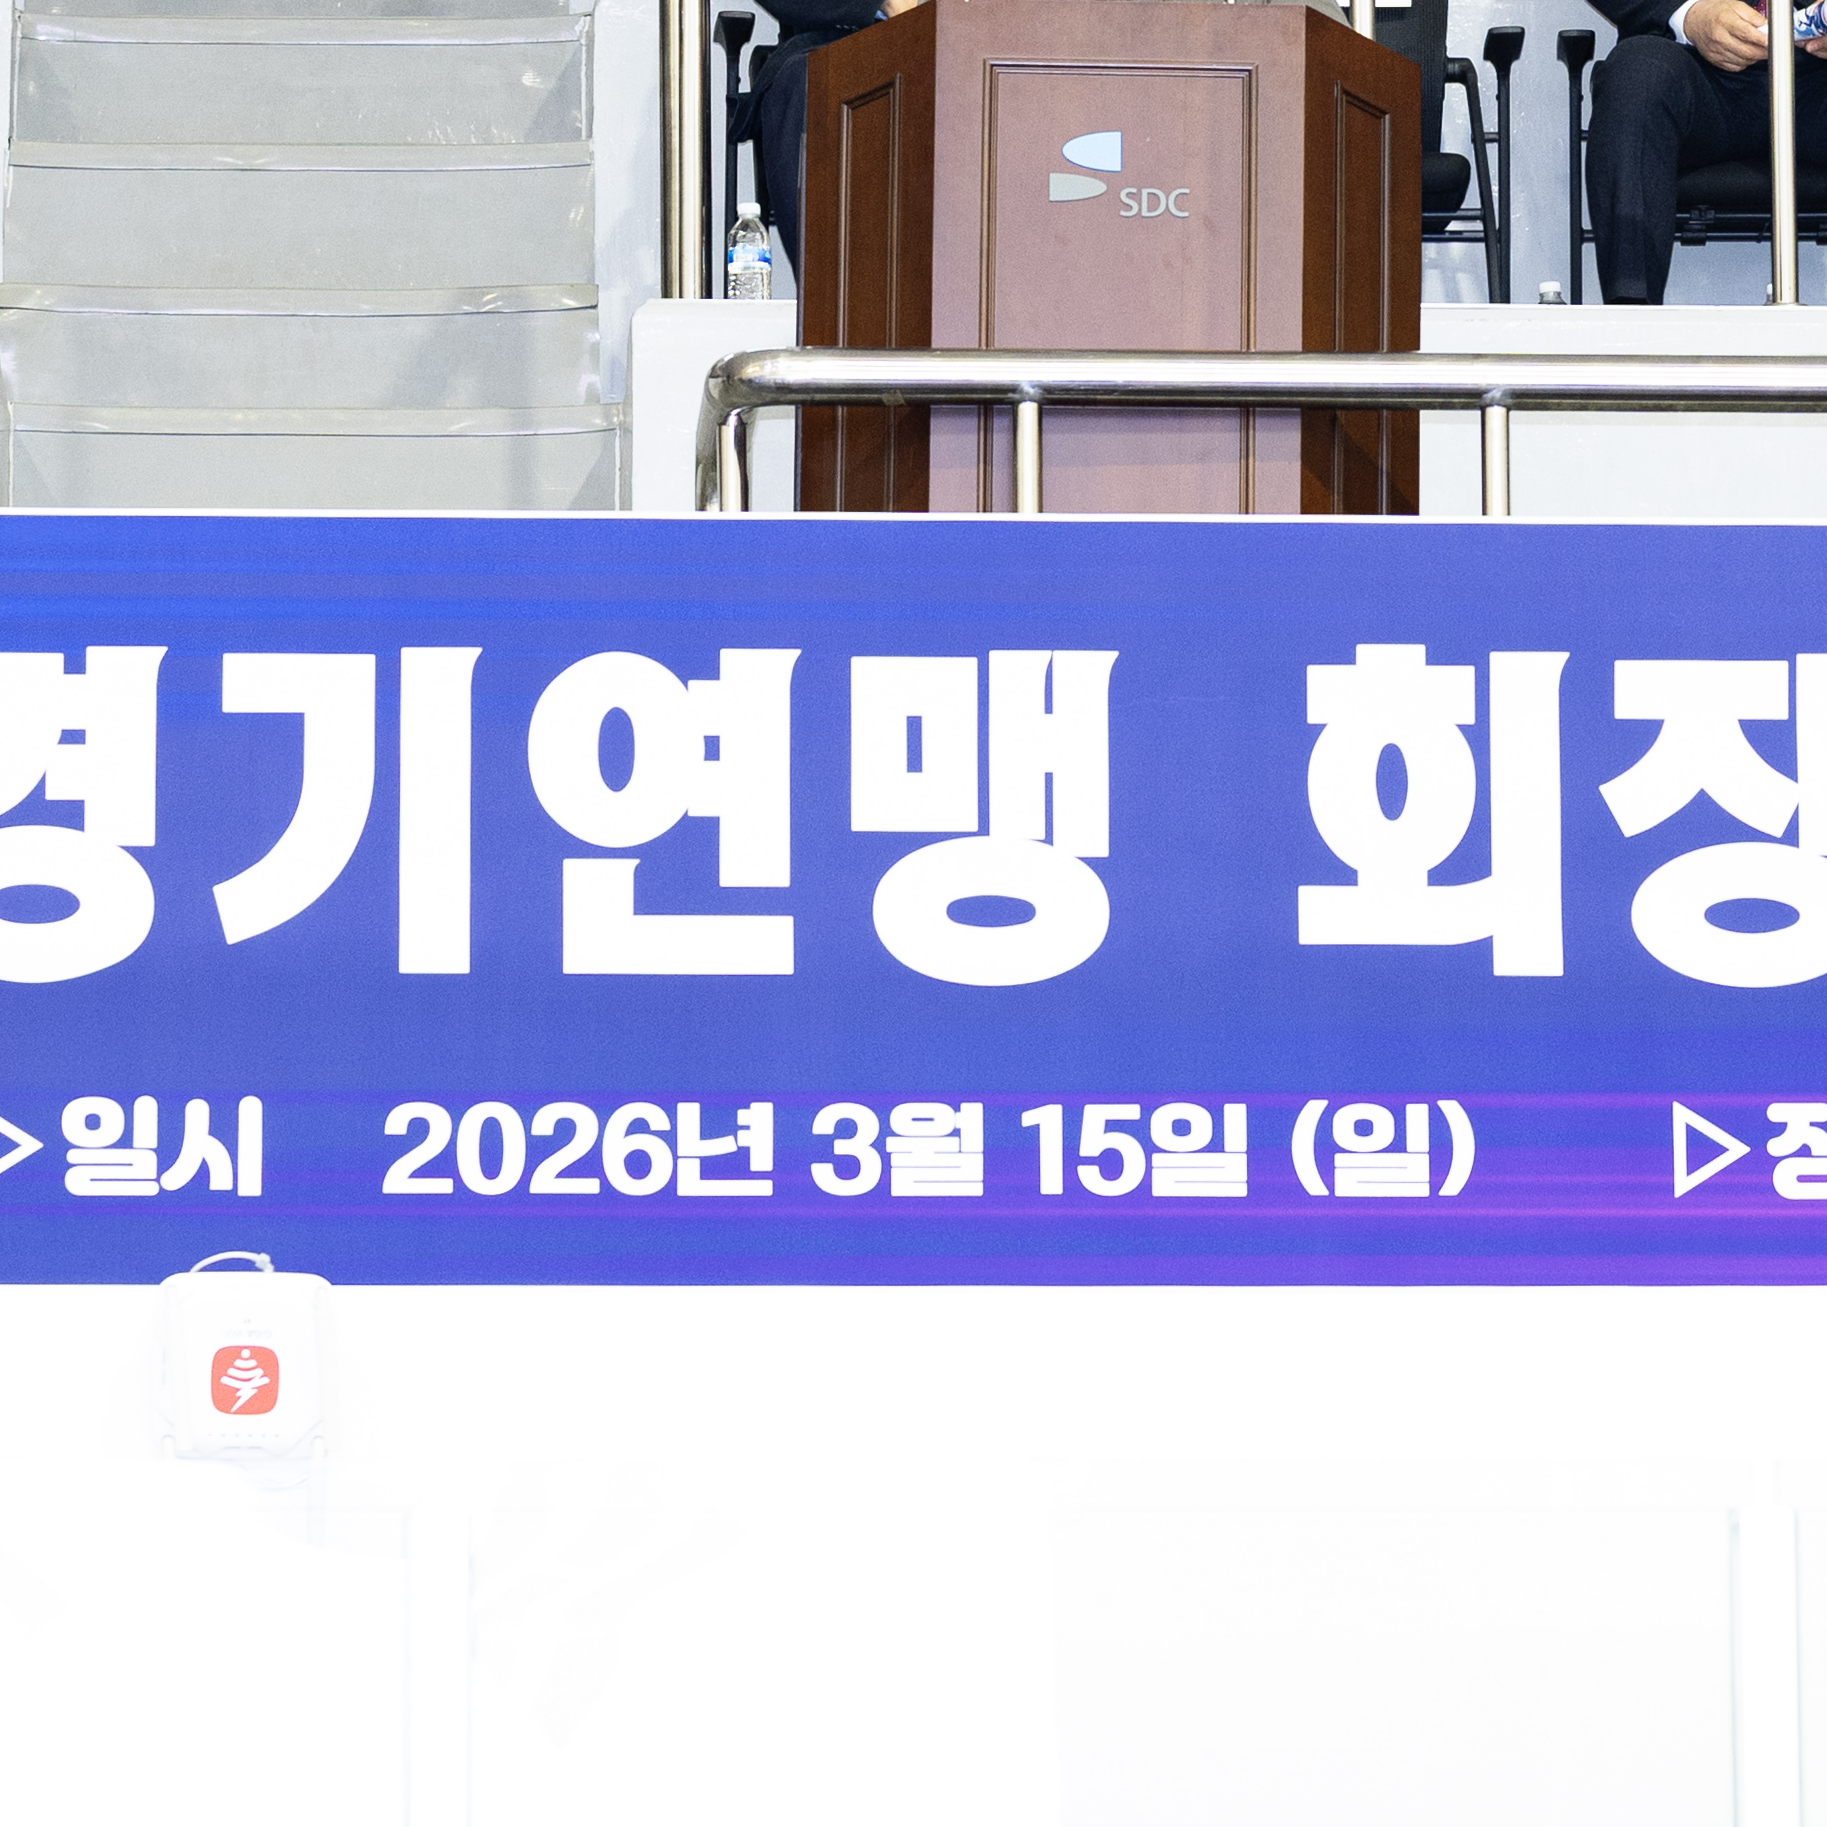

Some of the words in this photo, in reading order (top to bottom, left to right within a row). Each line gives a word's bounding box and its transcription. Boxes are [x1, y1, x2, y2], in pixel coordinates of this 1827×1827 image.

[1119, 187, 1191, 218] SDC
[61, 1095, 263, 1197] 일시
[382, 1101, 774, 1197] 2026년
[810, 1102, 984, 1197] 3월
[1021, 1102, 1248, 1197] 15일
[1291, 1099, 1475, 1198] (일)
